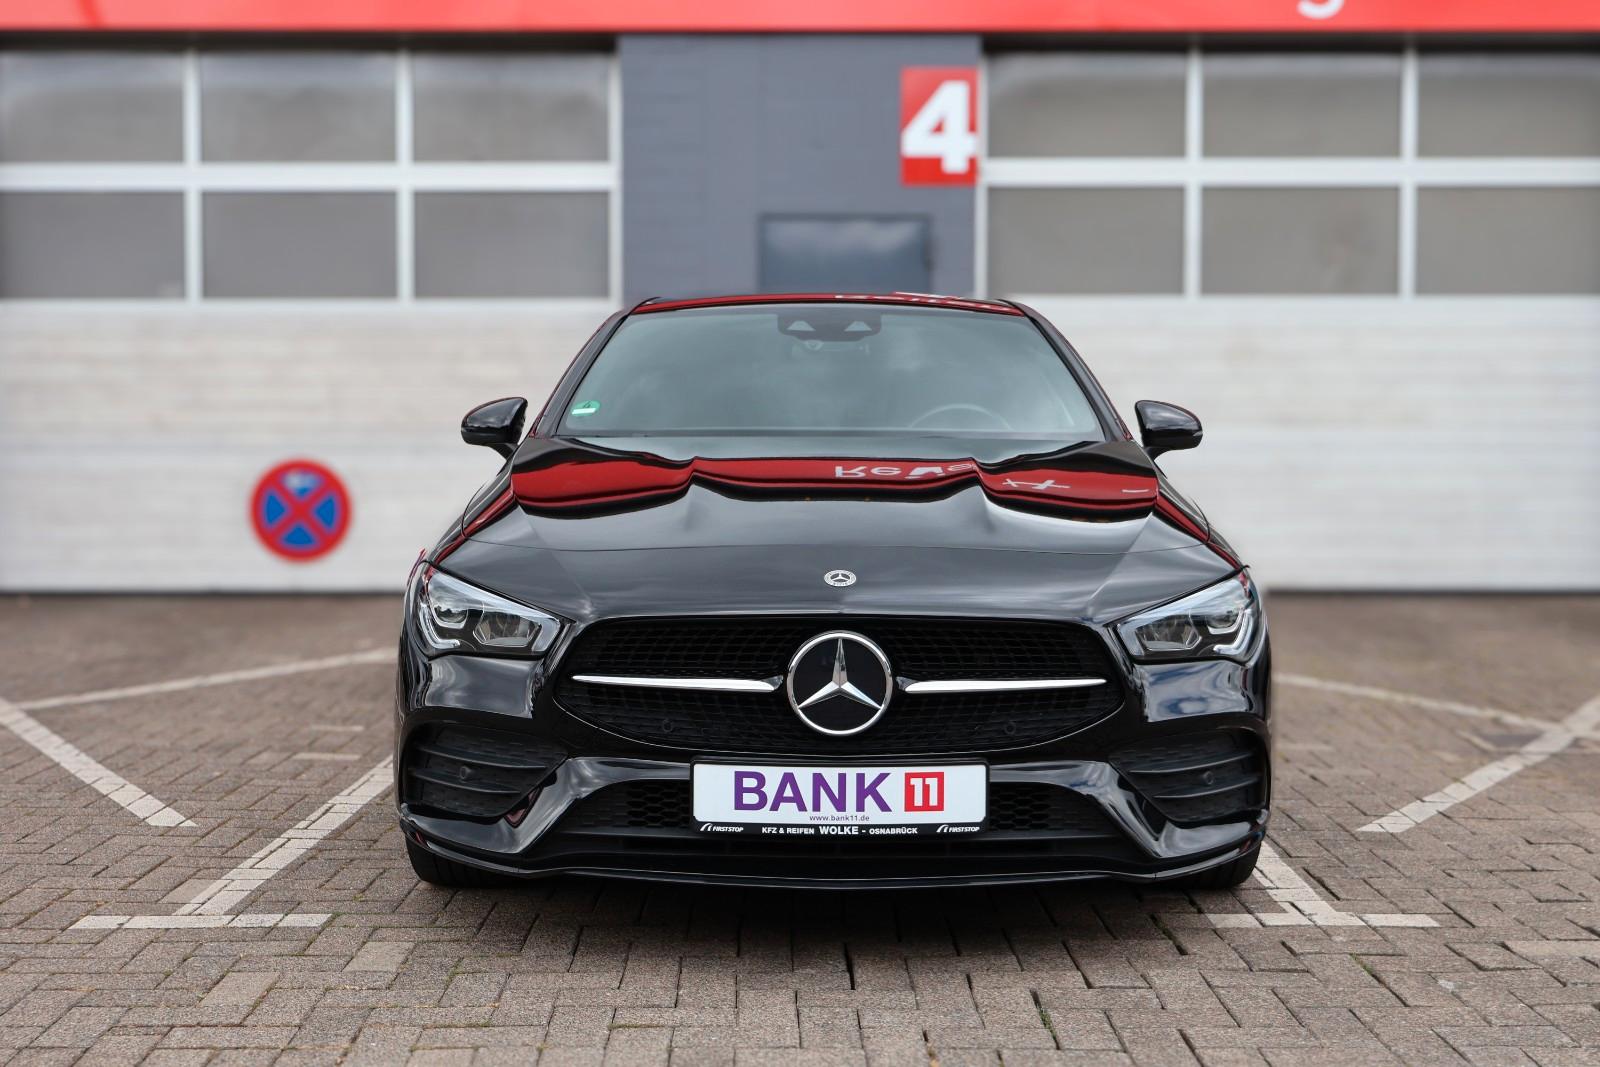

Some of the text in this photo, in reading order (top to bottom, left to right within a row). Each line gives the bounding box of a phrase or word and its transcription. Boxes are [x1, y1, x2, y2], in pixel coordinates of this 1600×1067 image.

[901, 79, 978, 174] 4
[734, 771, 938, 812] BANK 11
[809, 814, 870, 822] www.bank11.de
[819, 826, 859, 835] WOLKE
[869, 827, 918, 835] OSNABRÜCK
